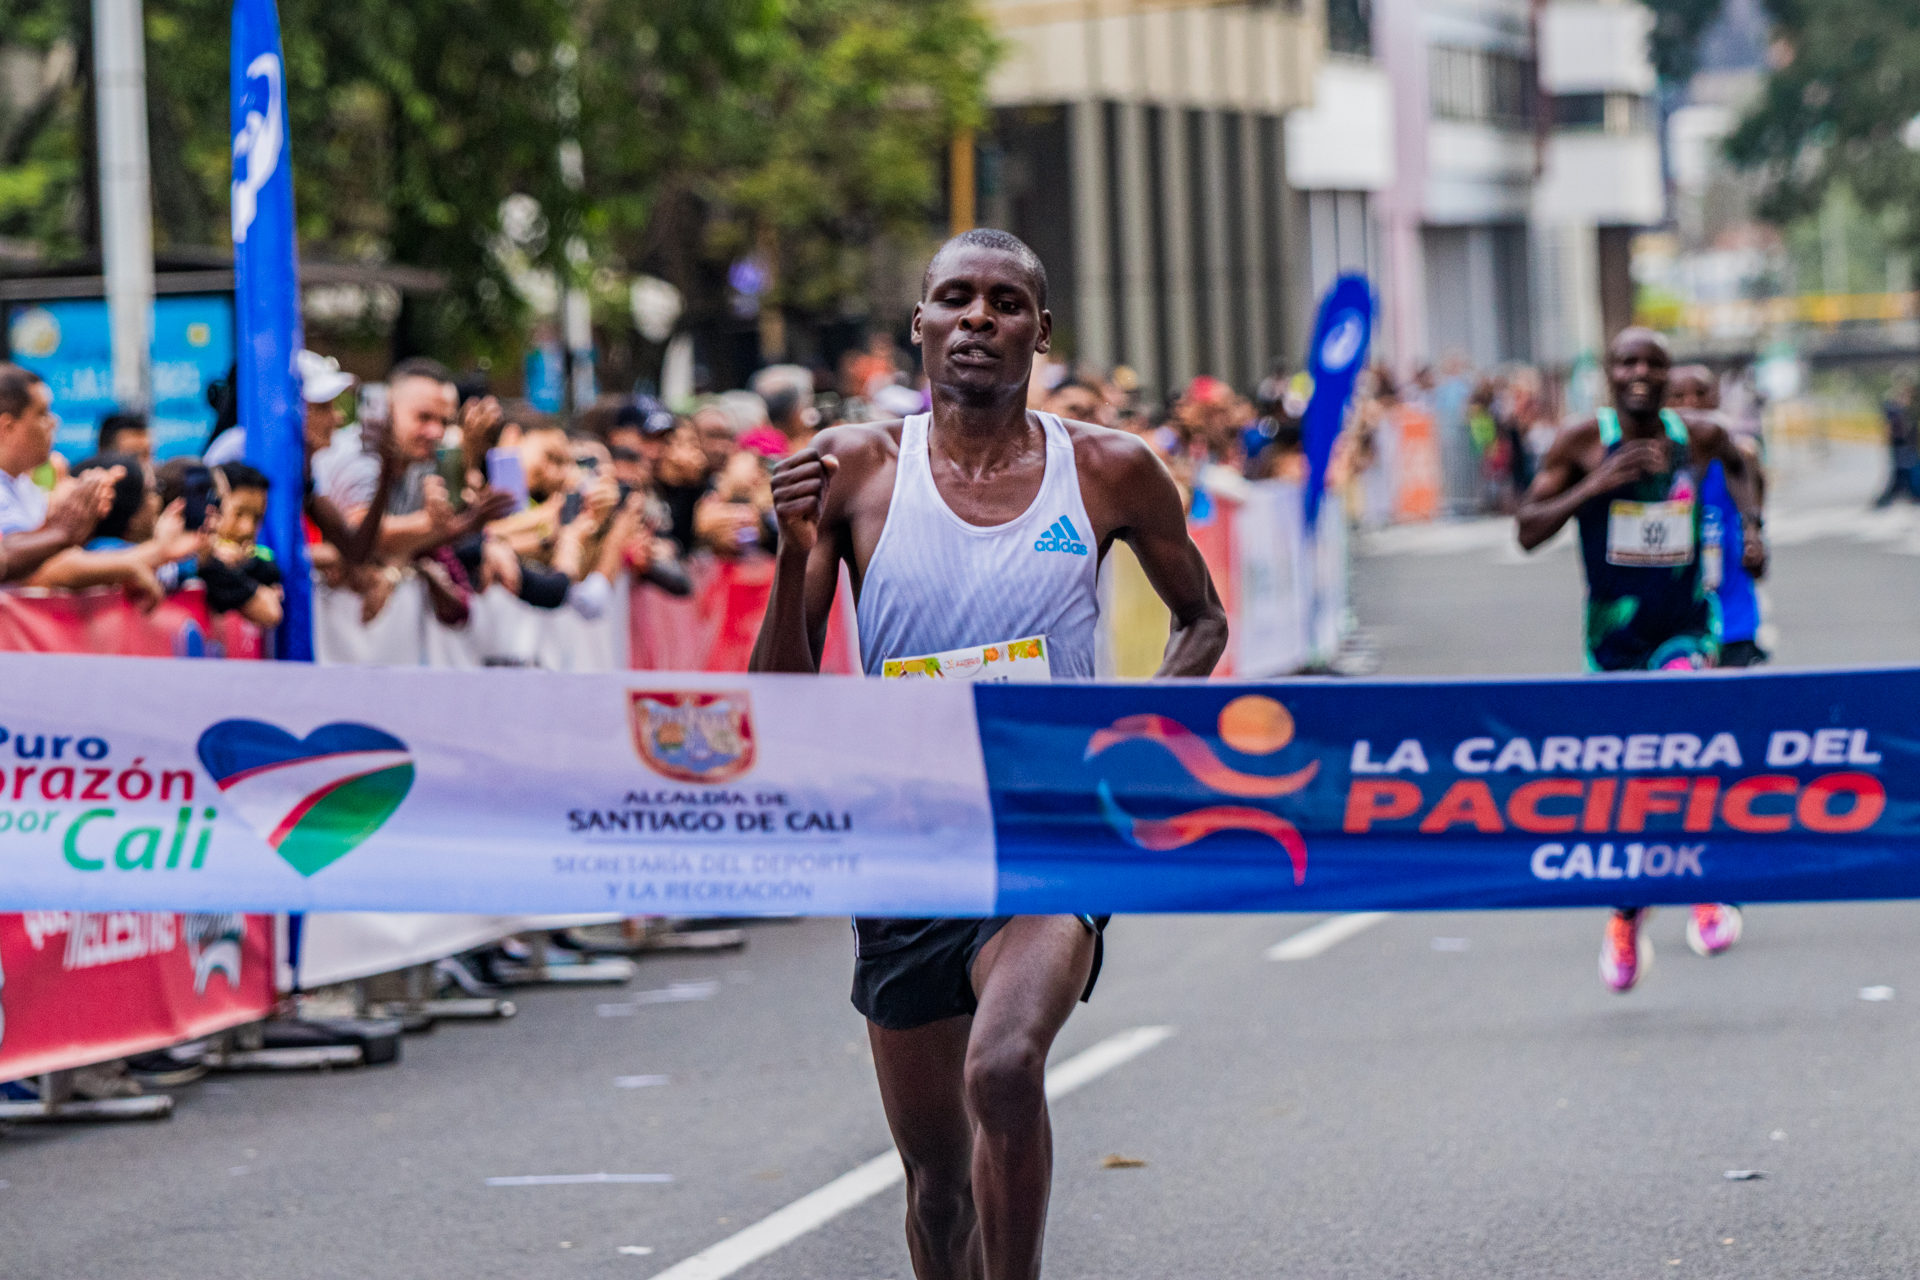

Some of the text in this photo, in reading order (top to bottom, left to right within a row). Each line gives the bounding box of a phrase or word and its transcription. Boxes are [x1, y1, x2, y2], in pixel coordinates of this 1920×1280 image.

[1034, 538, 1088, 556] adidas
[1350, 729, 1882, 774] LA CARRERA DEL
[0, 757, 196, 802] razón
[1343, 772, 1886, 834] PACIFICO
[567, 810, 853, 833] SANTIAGO DE CALI
[63, 807, 218, 871] Cali
[701, 855, 747, 875] DEL
[753, 854, 861, 874] DEPORTE
[605, 881, 620, 899] Y
[628, 881, 658, 899] LA
